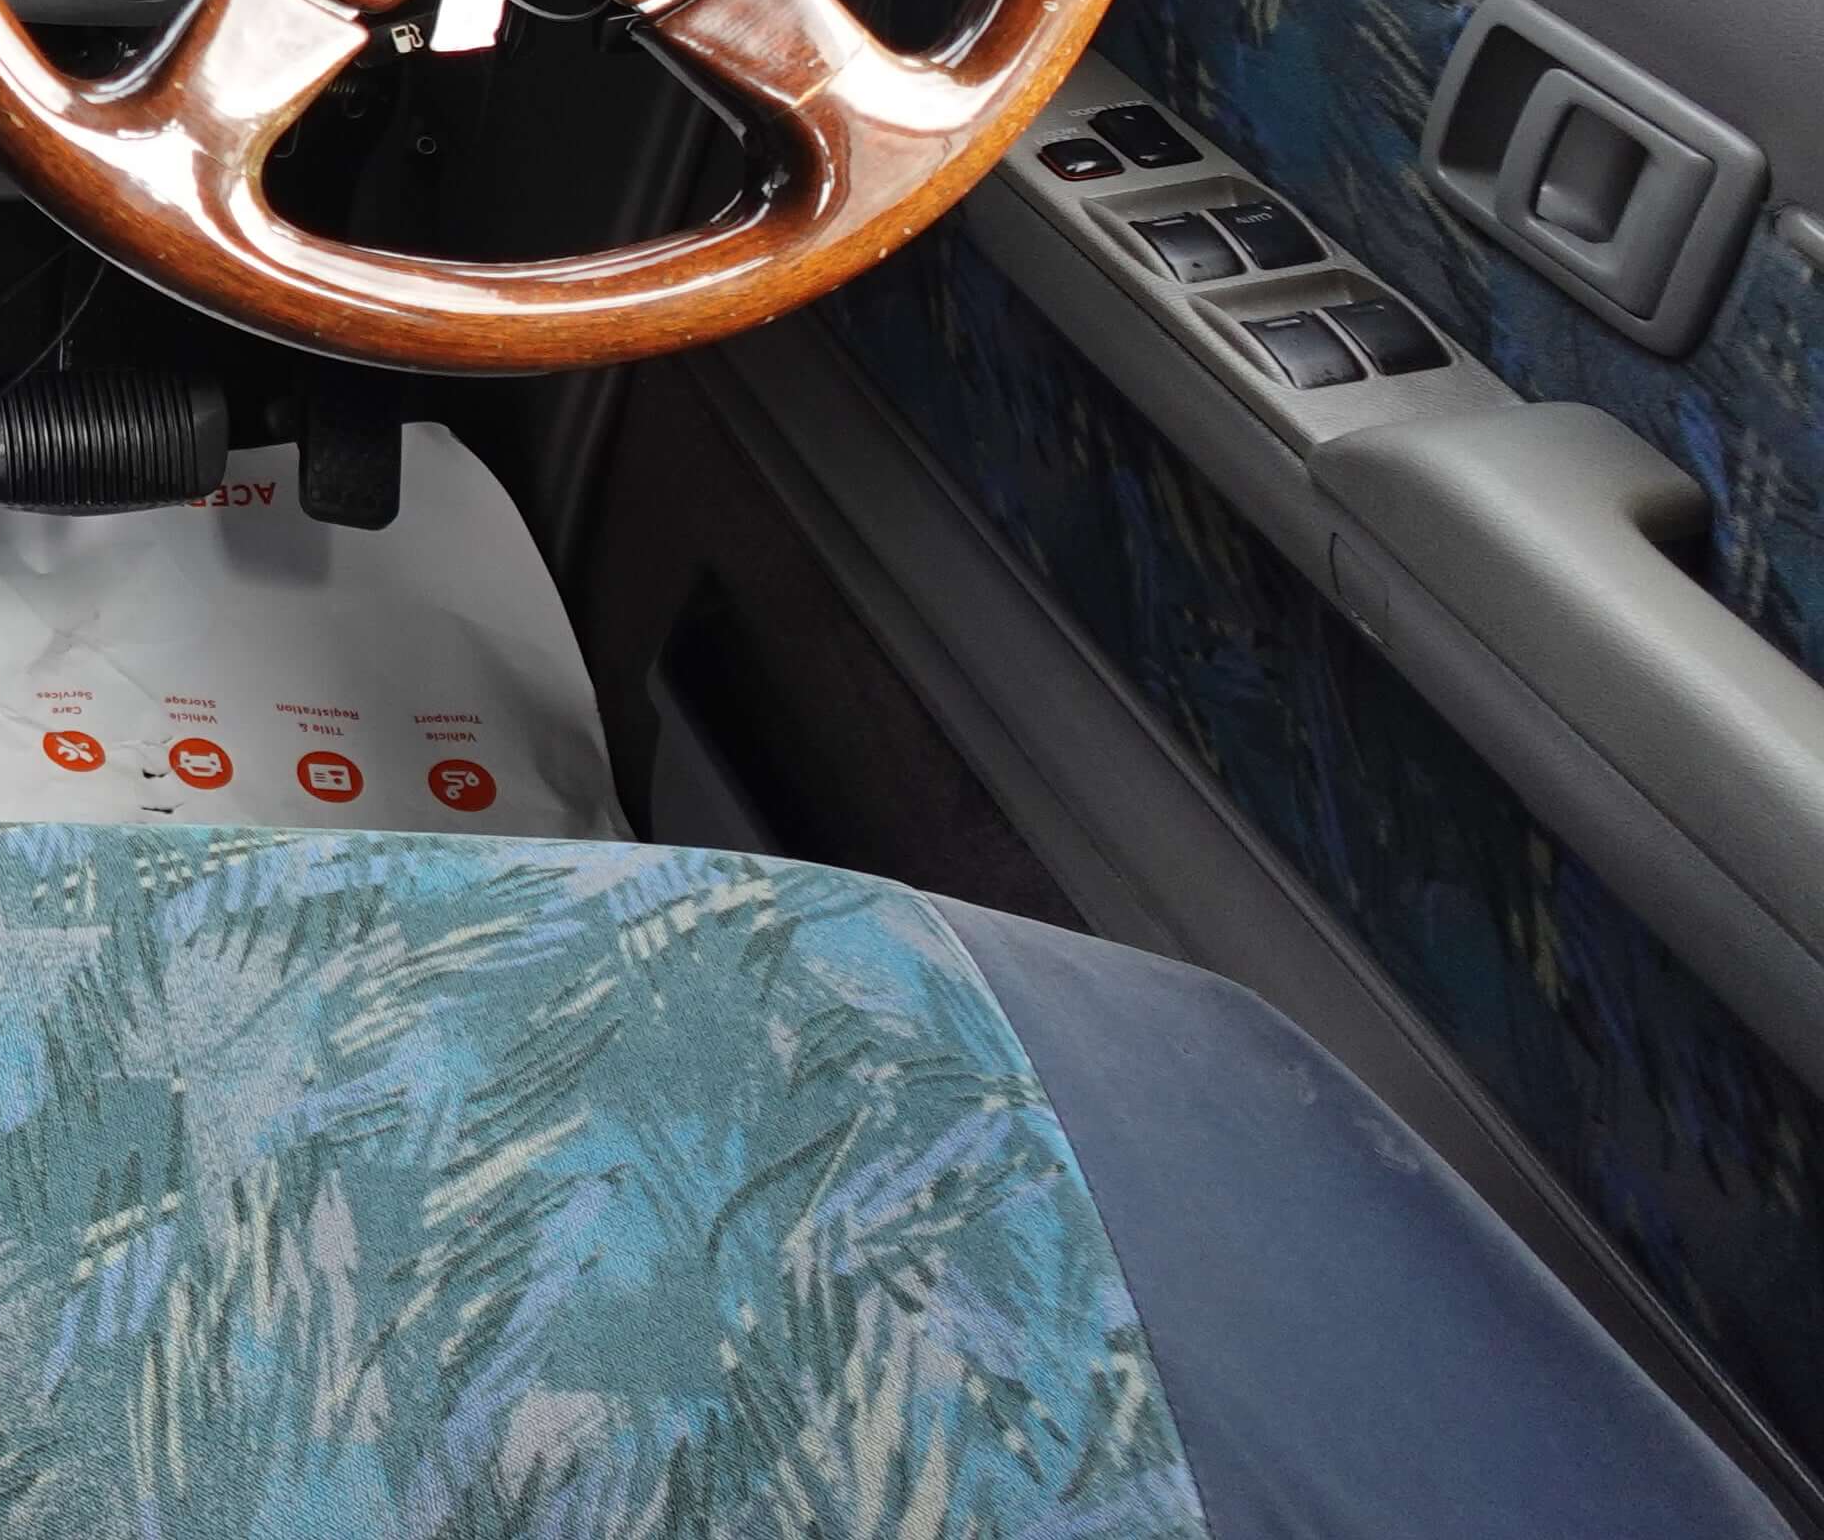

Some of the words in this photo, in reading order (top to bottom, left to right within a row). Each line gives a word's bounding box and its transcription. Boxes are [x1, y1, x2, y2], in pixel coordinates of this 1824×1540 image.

[36, 690, 93, 701] Services
[164, 694, 217, 709] Storage
[52, 706, 83, 716] Care
[275, 702, 361, 721] Registration
[169, 711, 219, 725] Vehicle
[414, 714, 483, 725] Transport
[312, 724, 344, 737] Title
[425, 731, 477, 742] Vehicle
